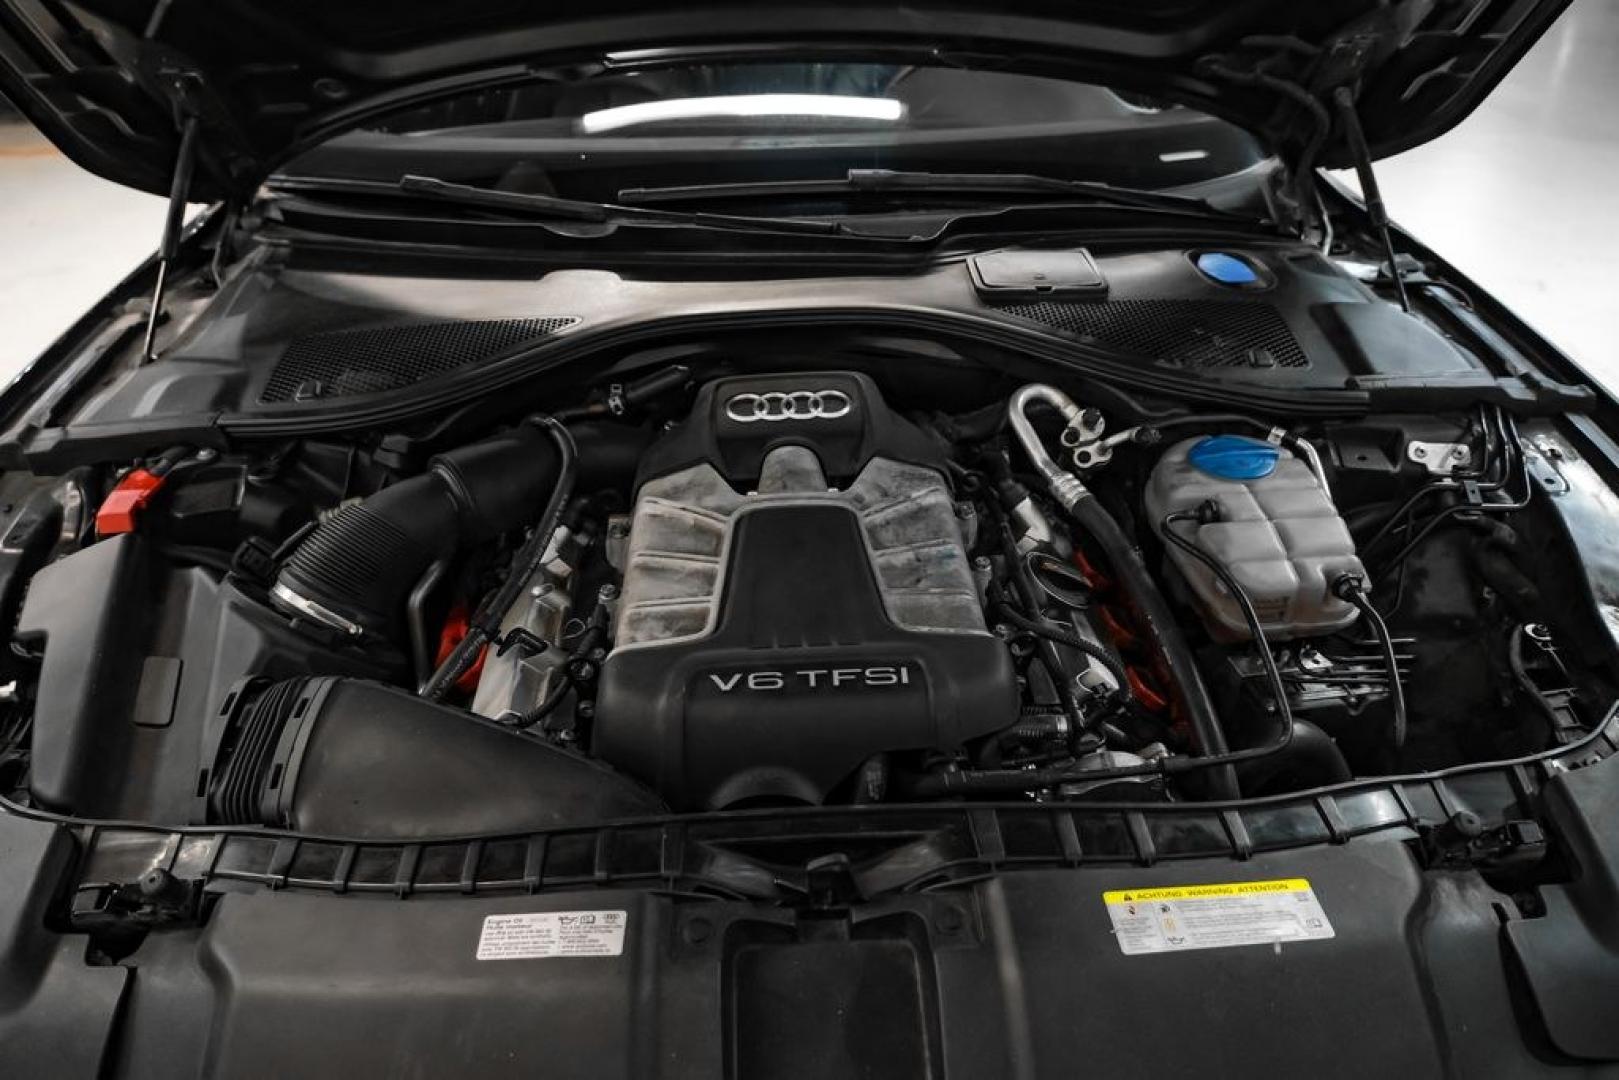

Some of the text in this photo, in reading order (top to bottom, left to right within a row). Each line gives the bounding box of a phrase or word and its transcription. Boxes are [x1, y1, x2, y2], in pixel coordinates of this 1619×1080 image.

[709, 666, 909, 691] V6 TFSI
[1136, 884, 1289, 900] ACHTUNG WARNING ATTENTION
